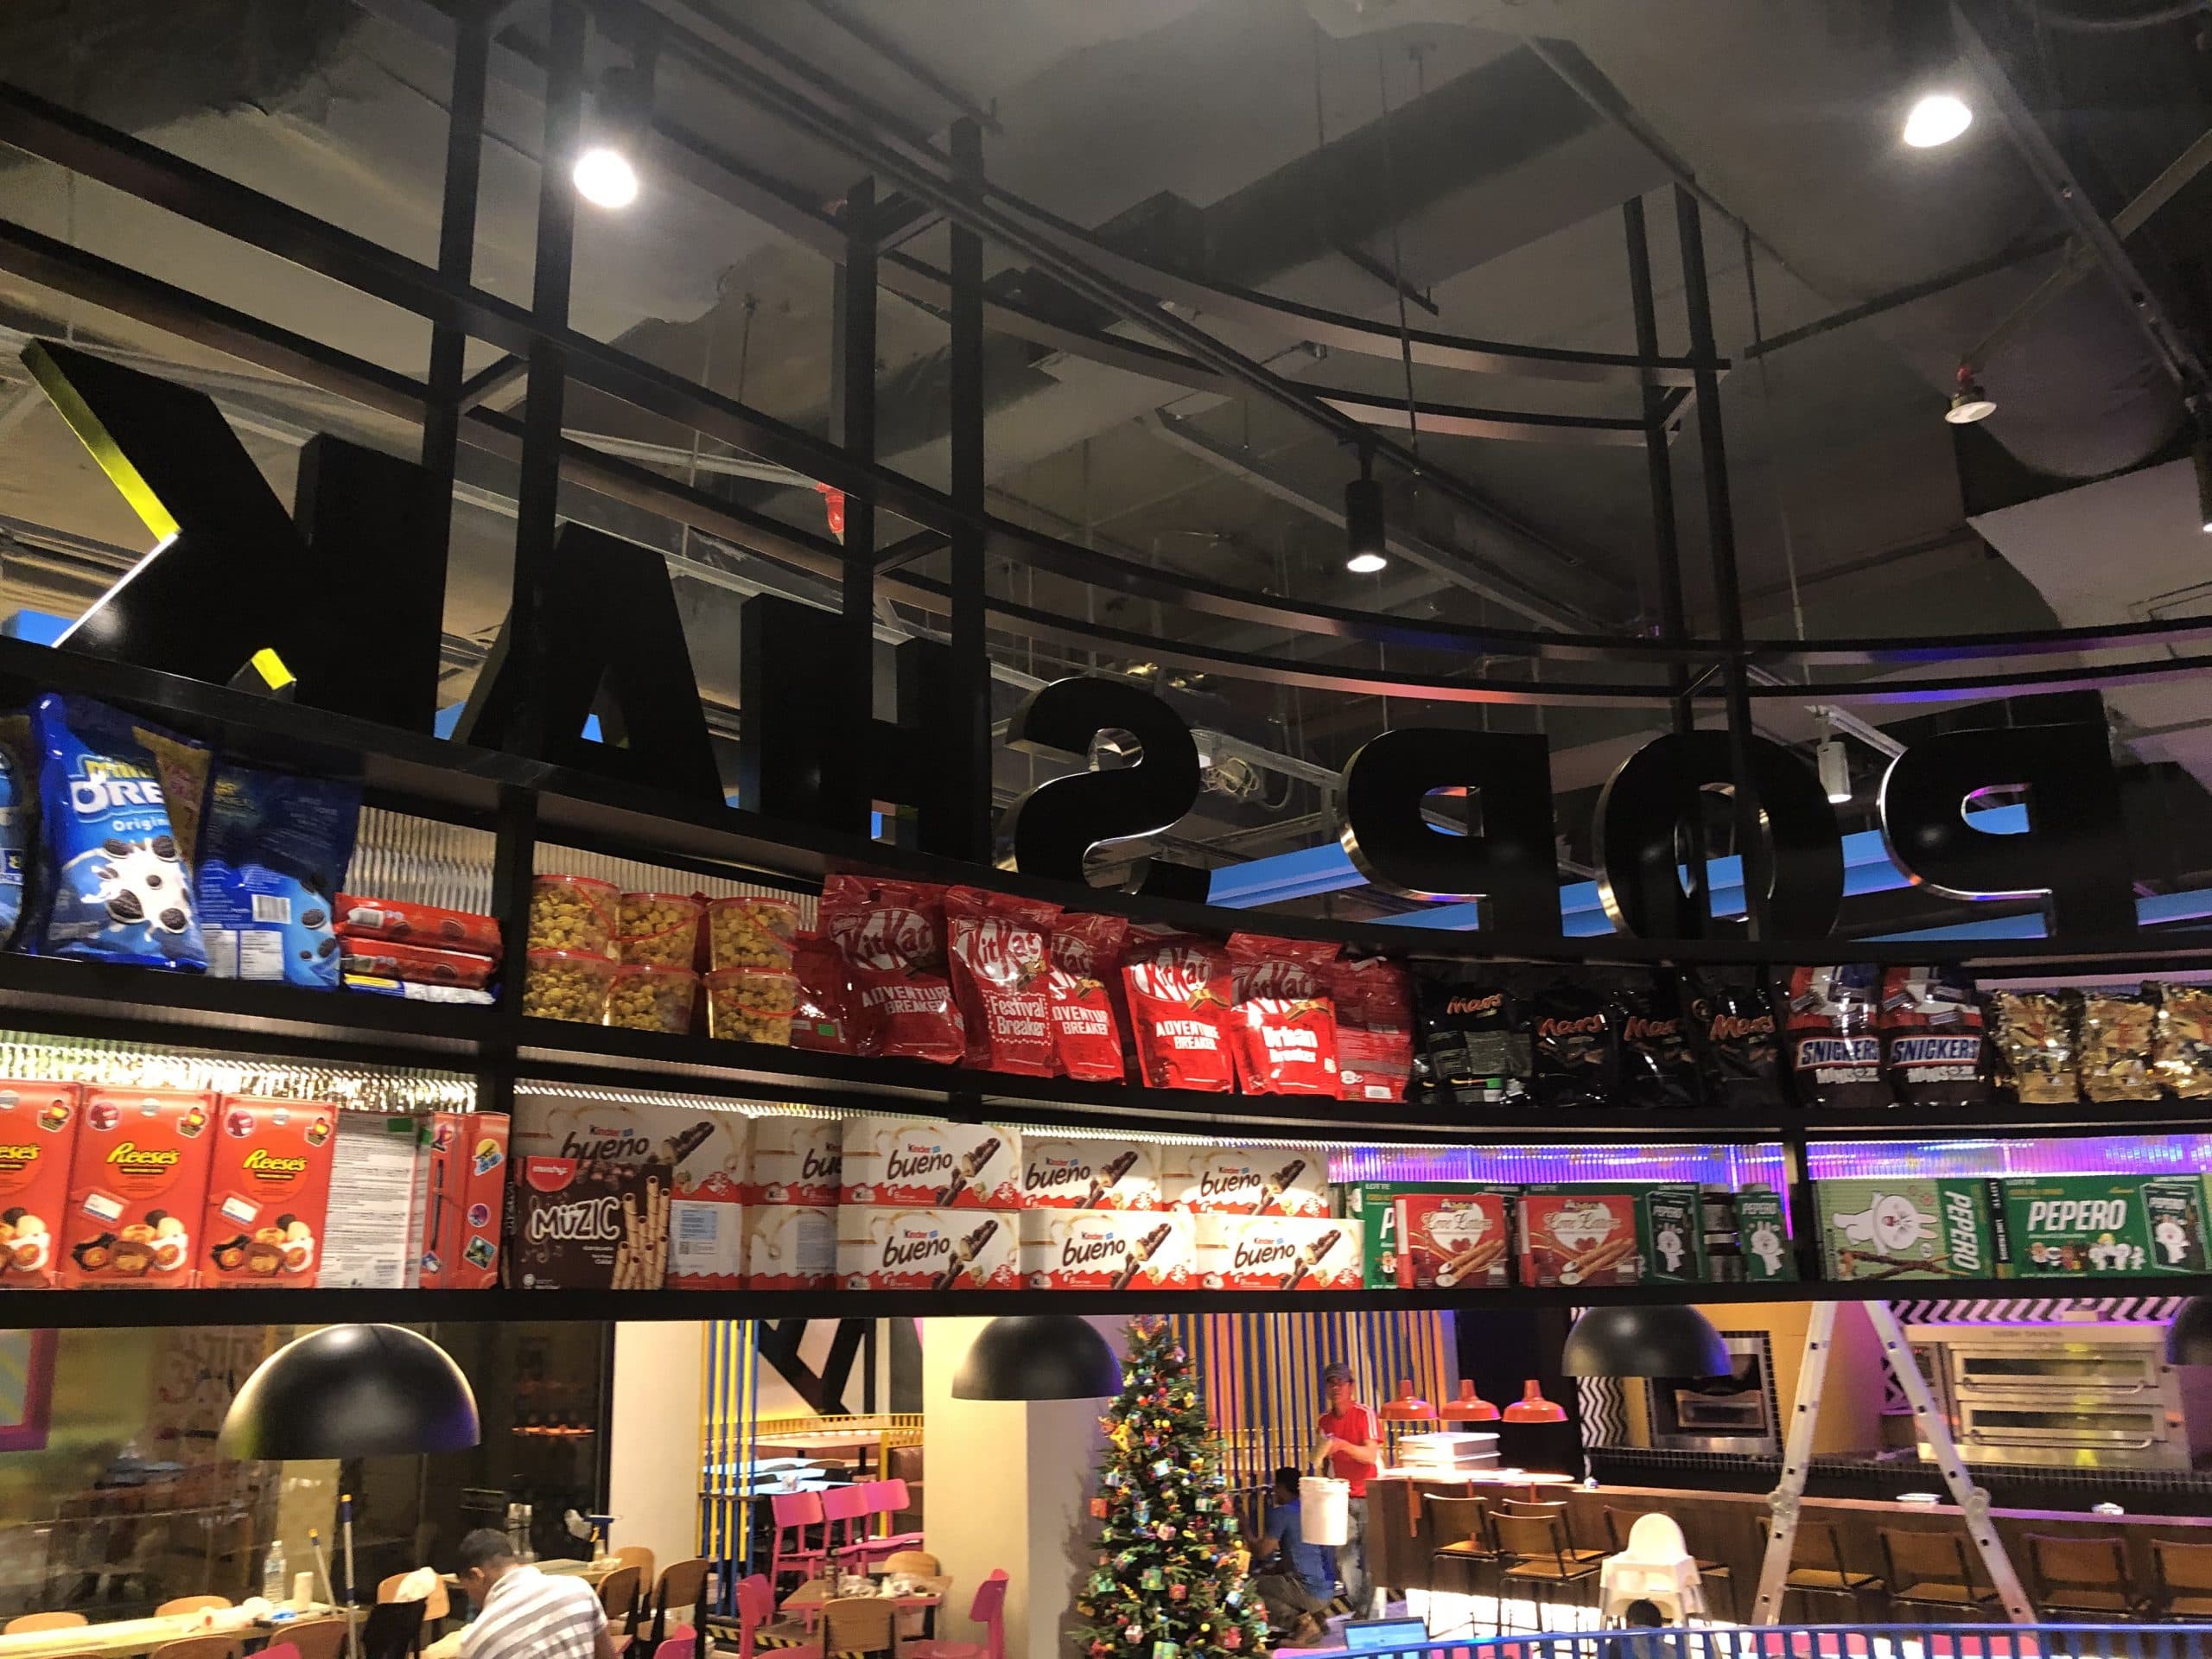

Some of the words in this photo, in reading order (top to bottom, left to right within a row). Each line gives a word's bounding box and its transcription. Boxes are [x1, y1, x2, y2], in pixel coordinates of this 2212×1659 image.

[70, 780, 168, 814] ORE
[990, 995, 1046, 1018] Festival
[996, 1016, 1045, 1037] Breaker
[1802, 1039, 1880, 1065] SNICKERS
[1894, 1039, 1978, 1064] SNICKERS
[106, 1141, 180, 1165] Reese's
[242, 1147, 308, 1171] Reese's
[560, 1130, 649, 1160] bueno
[887, 1148, 953, 1180] bueno
[1025, 1162, 1091, 1191] bueno
[1200, 1171, 1262, 1198] bueno
[2026, 1198, 2127, 1231] PEPERO
[1944, 1190, 1981, 1271] PEPERO
[882, 1235, 950, 1268] bueno
[1062, 1237, 1126, 1267] bueno
[1234, 1242, 1295, 1269] bueno
